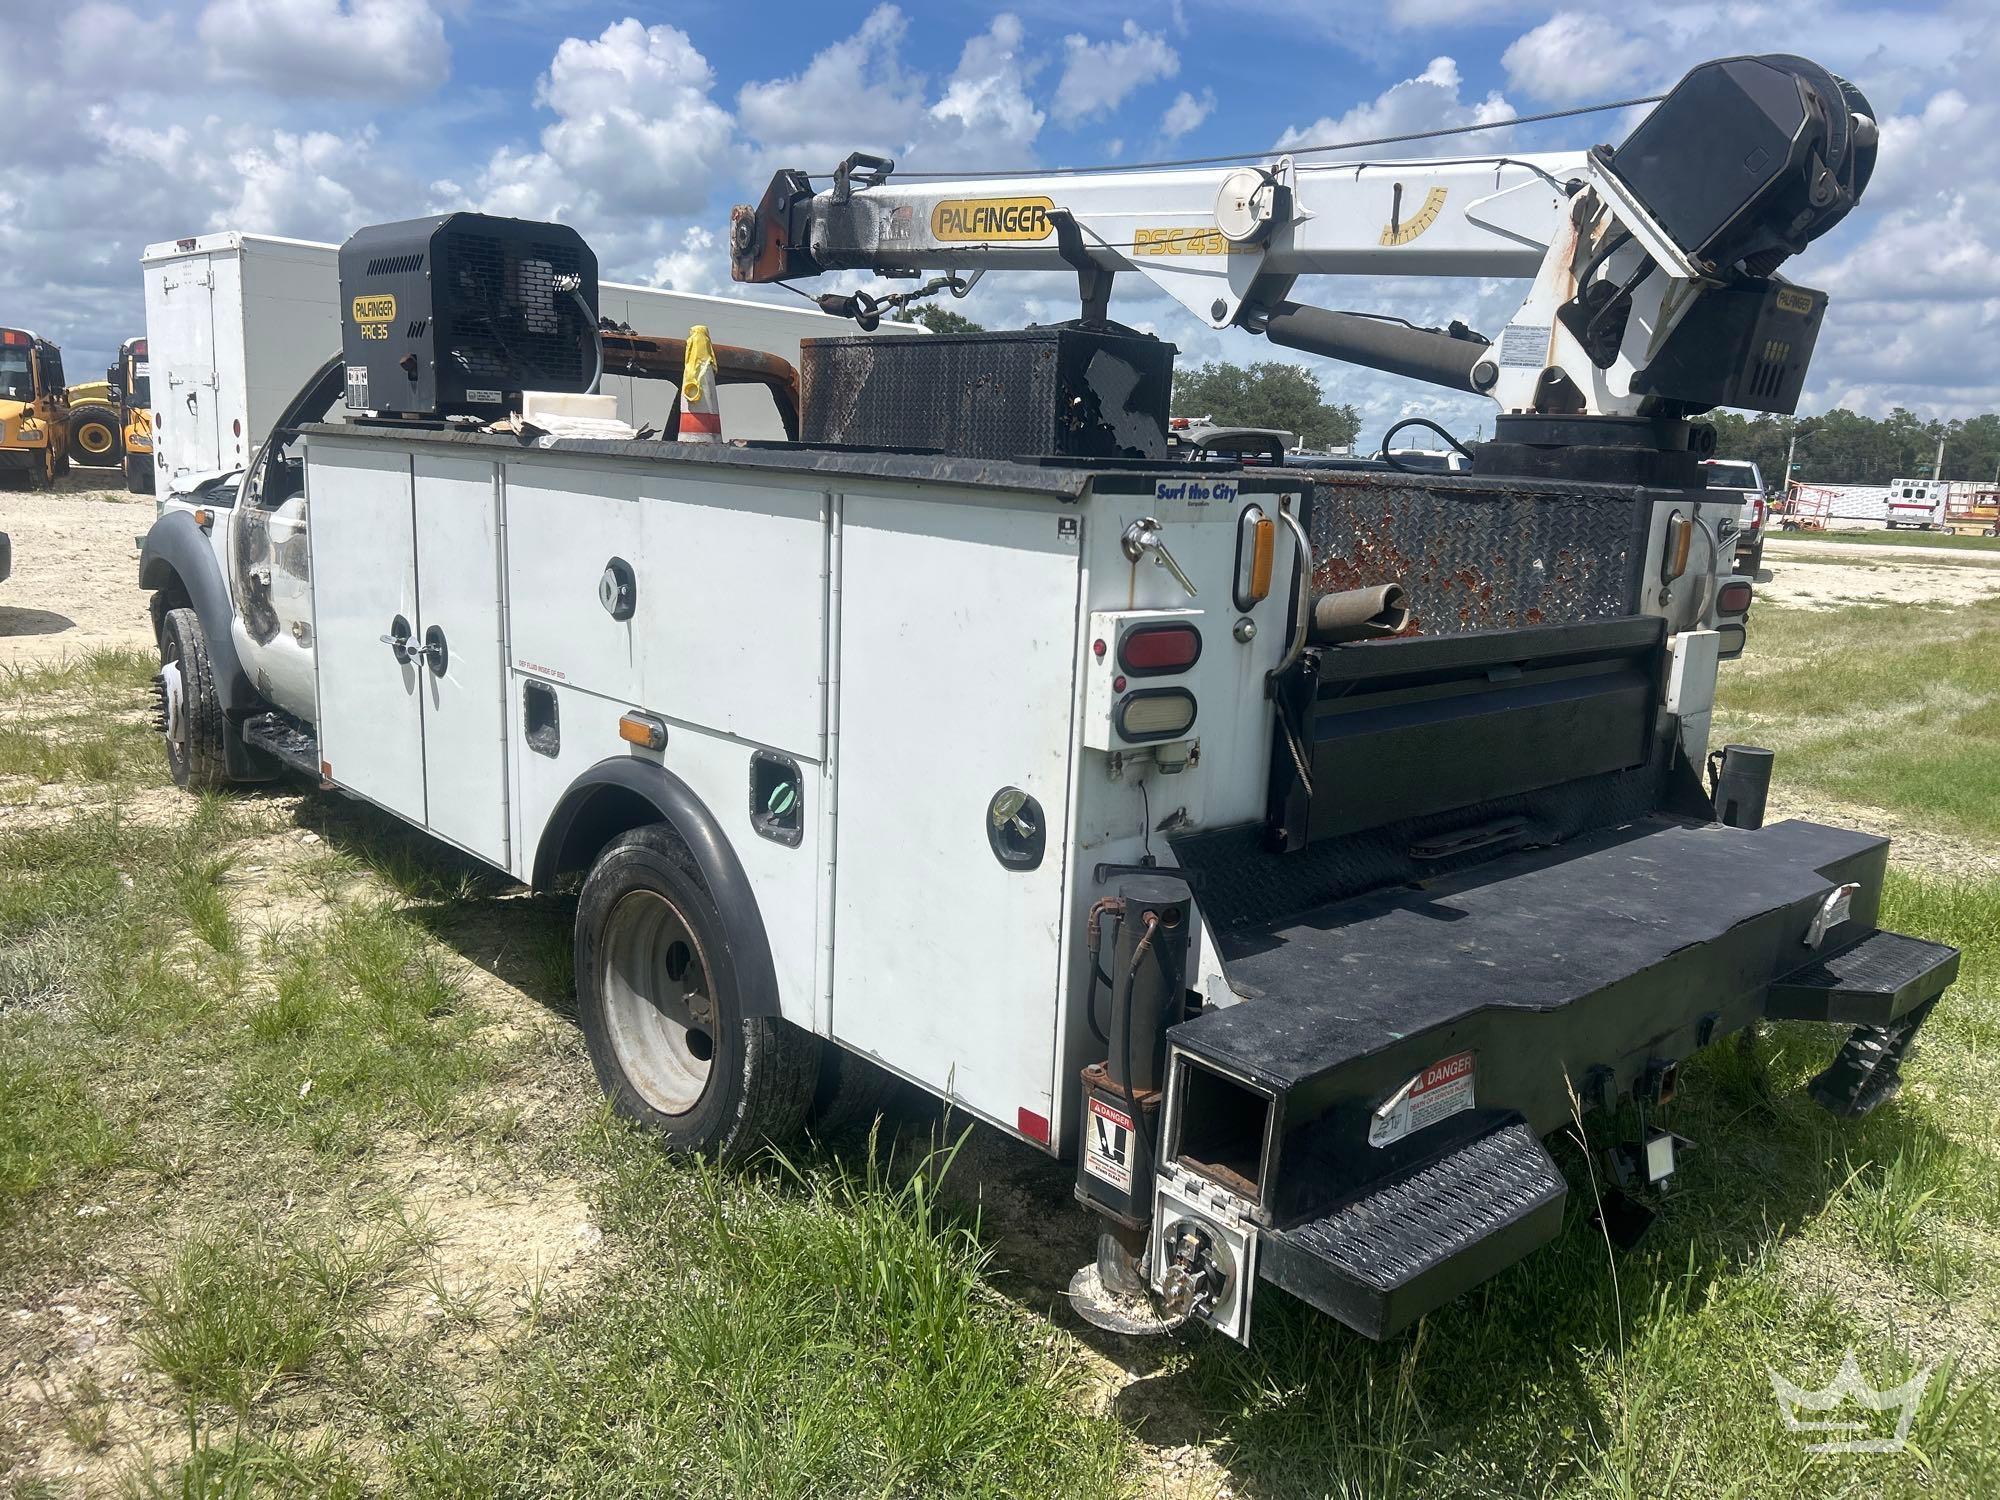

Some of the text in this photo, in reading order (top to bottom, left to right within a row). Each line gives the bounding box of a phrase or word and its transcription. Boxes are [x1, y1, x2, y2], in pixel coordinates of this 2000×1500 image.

[938, 204, 1047, 233] PALFINGER
[1133, 228, 1184, 255] PSC
[355, 300, 393, 318] PALFINGER
[361, 324, 388, 340] PRC 35
[1157, 482, 1238, 503] Surf the City
[527, 662, 537, 671] FLUID
[1427, 1056, 1472, 1086] DANGER
[1101, 1104, 1130, 1127] DANGER
